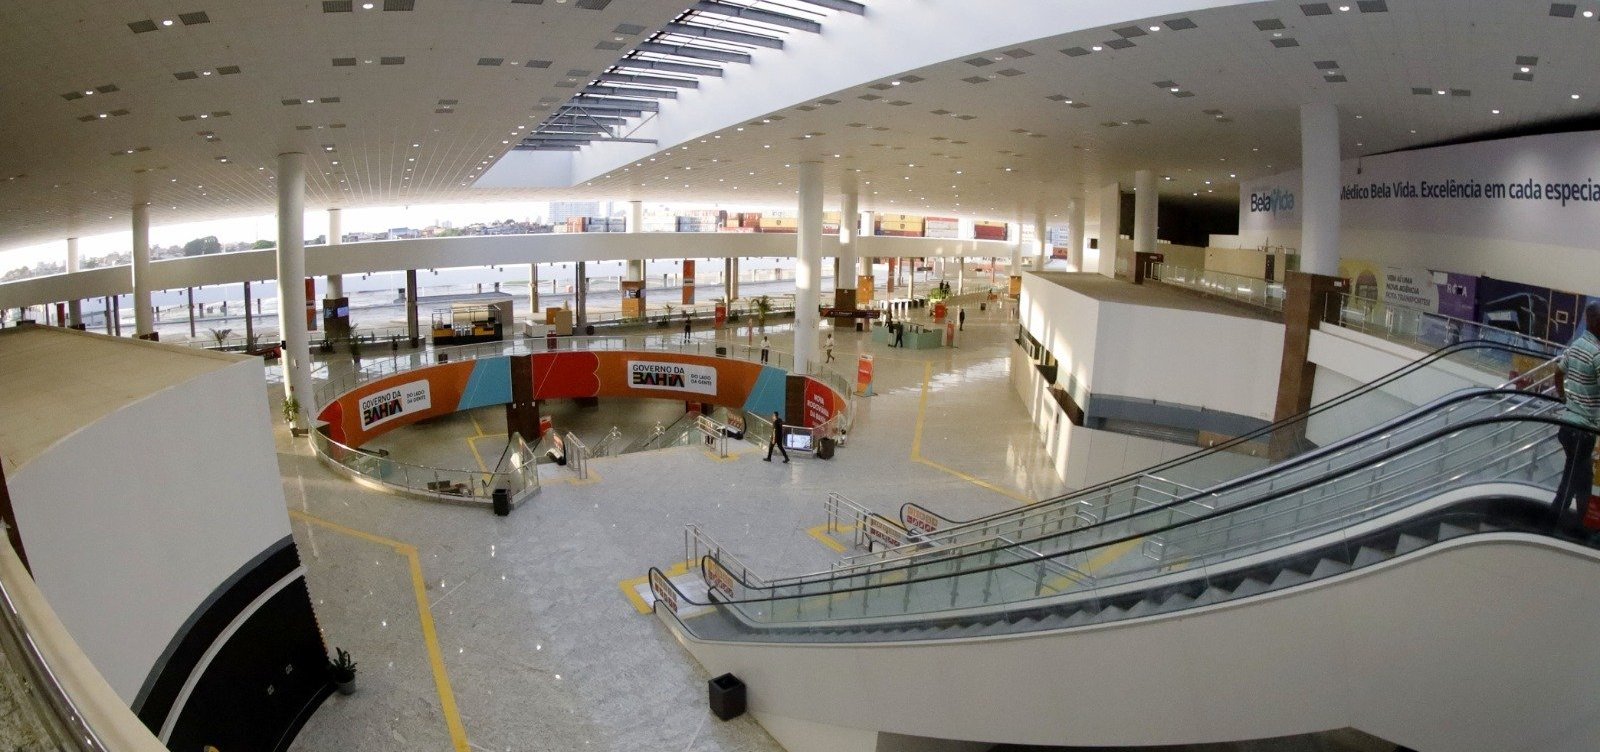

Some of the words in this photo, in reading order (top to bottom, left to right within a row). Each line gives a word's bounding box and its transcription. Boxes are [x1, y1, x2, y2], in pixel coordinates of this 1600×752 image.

[1371, 183, 1391, 199] Bela
[1392, 181, 1419, 198] Vida.
[1421, 179, 1482, 198] Excelência
[1484, 183, 1505, 198] em
[1508, 178, 1542, 199] cada
[1545, 177, 1600, 207] especia
[632, 365, 672, 373] GOVERNO
[633, 372, 685, 387] BAHIA
[363, 393, 391, 410] GOVERNO
[392, 390, 401, 399] DA
[363, 399, 403, 426] BAHIA
